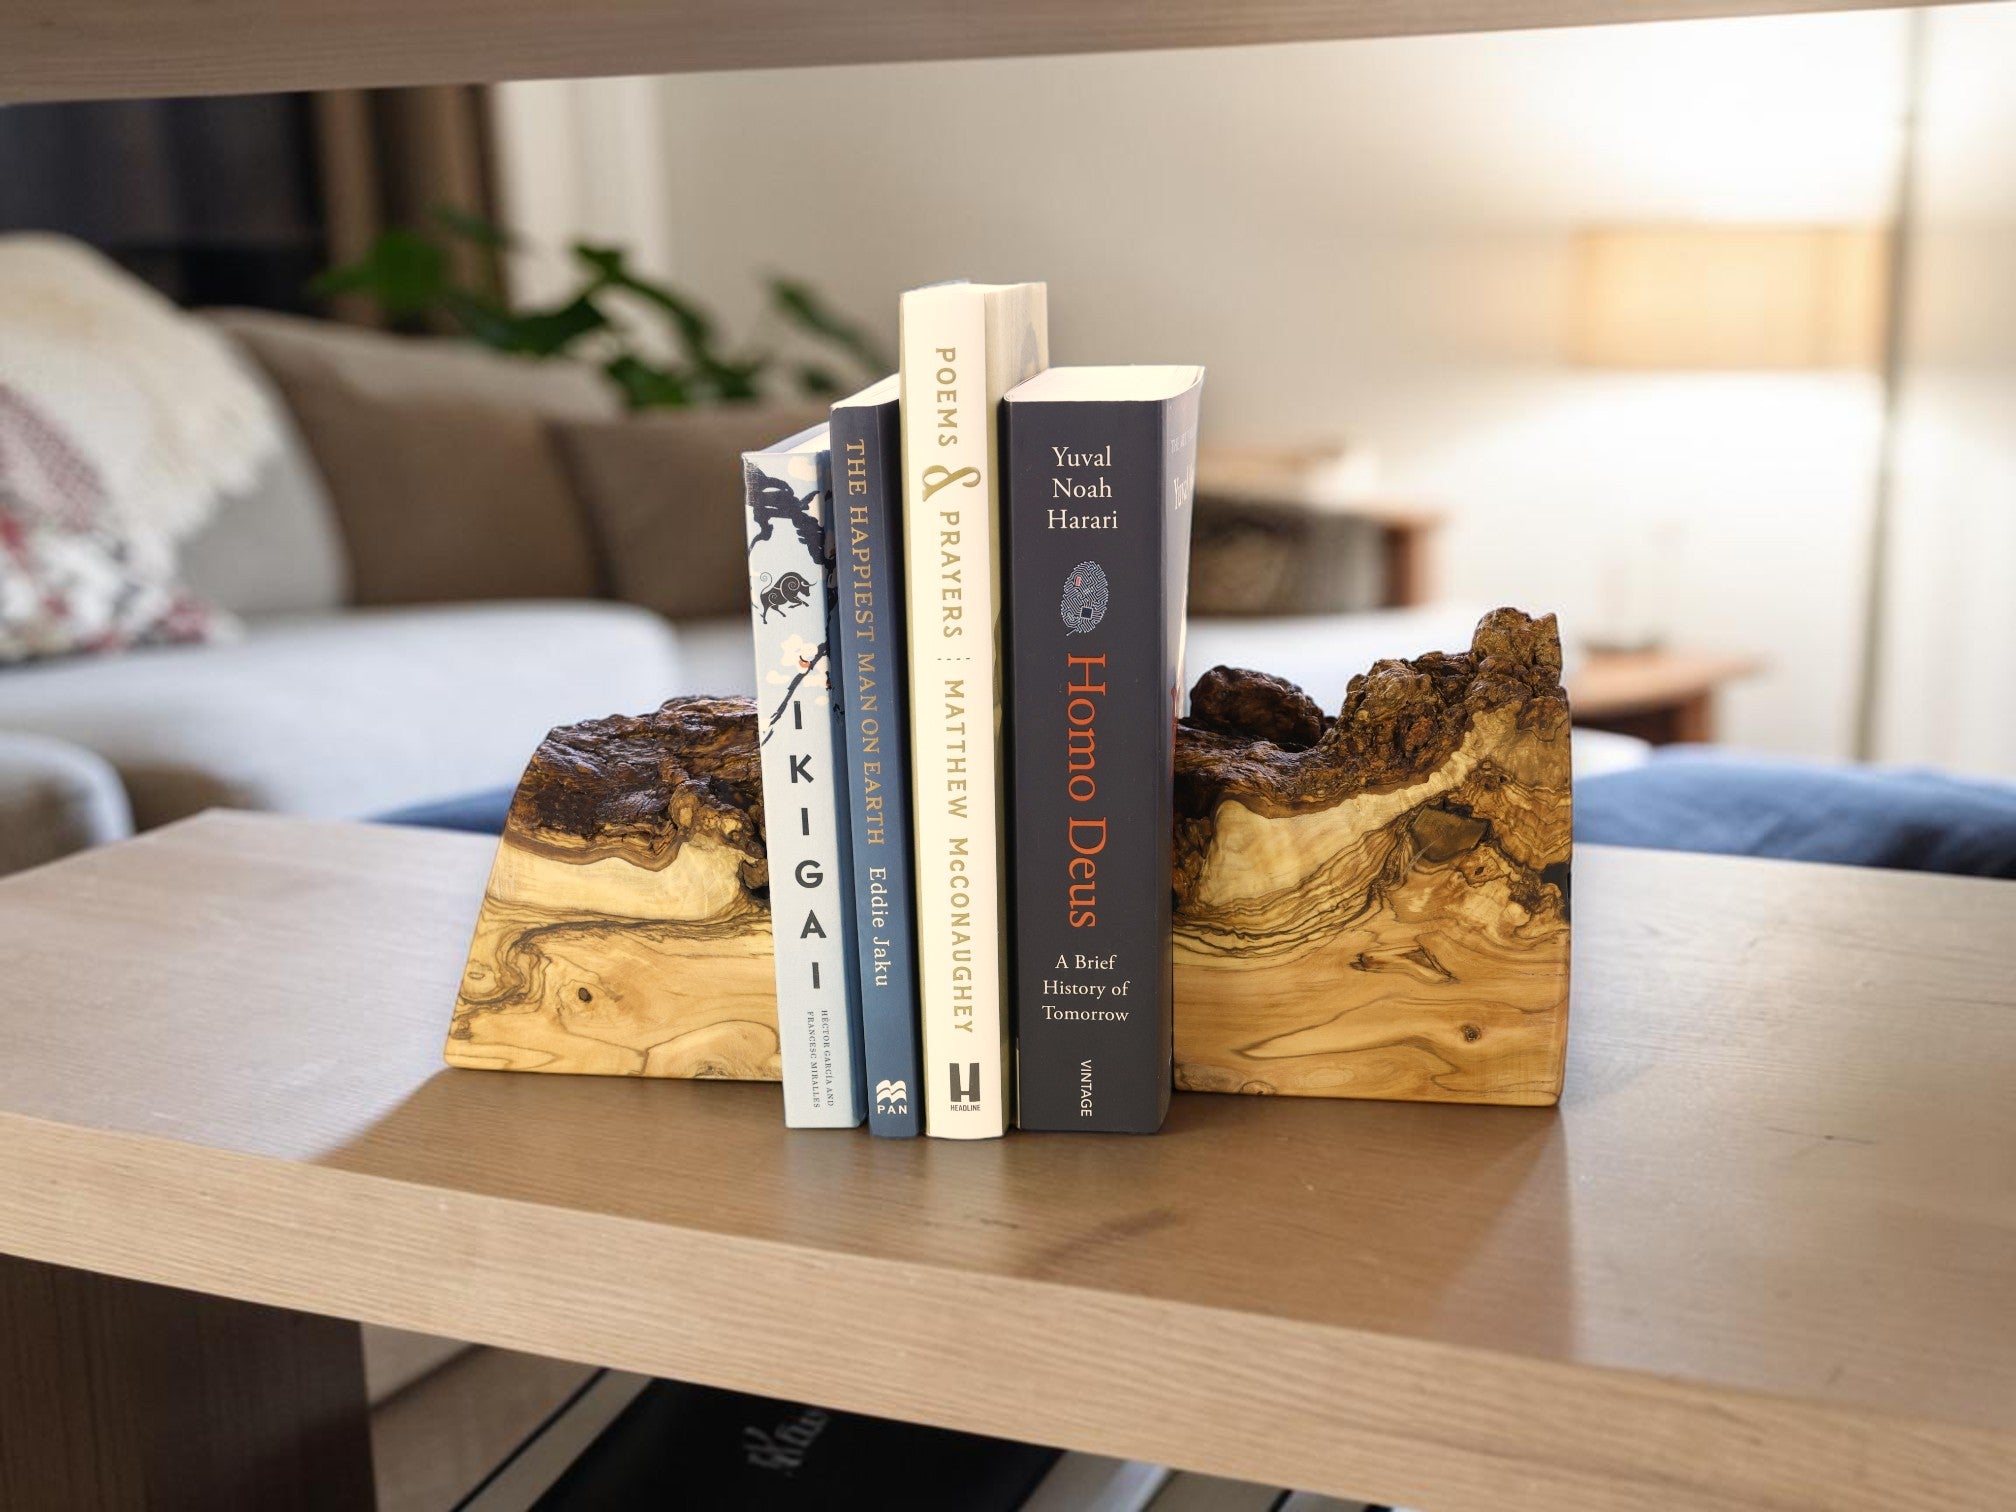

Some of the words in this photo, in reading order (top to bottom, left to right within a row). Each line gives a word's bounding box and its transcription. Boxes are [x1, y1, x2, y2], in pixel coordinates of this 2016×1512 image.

[936, 347, 958, 447] POEMS
[846, 439, 867, 496] THE
[1051, 445, 1112, 467] Yuval
[922, 464, 982, 503] &
[1051, 476, 1112, 498] Noah
[1047, 509, 1118, 529] Harari
[850, 506, 875, 642] HAPPIEST
[940, 511, 963, 639] PRAYERS
[857, 653, 878, 712] MAN
[861, 718, 880, 754] ON
[944, 679, 968, 819] MATTHEW
[1067, 653, 1107, 802] Homo
[863, 762, 885, 845] EARTH
[789, 700, 827, 990] IKIGAI
[869, 867, 889, 928] Eddie
[1068, 816, 1107, 928] Deus
[949, 837, 974, 1034] McCONAUGHEY
[873, 936, 892, 987] Jaku
[1054, 954, 1069, 969] A
[1075, 954, 1117, 970] Brief
[1042, 1005, 1129, 1022] Tomorrow
[1043, 980, 1106, 1000] History
[1111, 981, 1131, 996] of
[807, 1011, 817, 1059] FRANCESC
[810, 1061, 820, 1108] MIRALLES
[826, 1087, 834, 1107] AND
[877, 1105, 908, 1115] PAN
[950, 1104, 981, 1112] HEADLINE
[1080, 1059, 1093, 1117] VINTAGE
